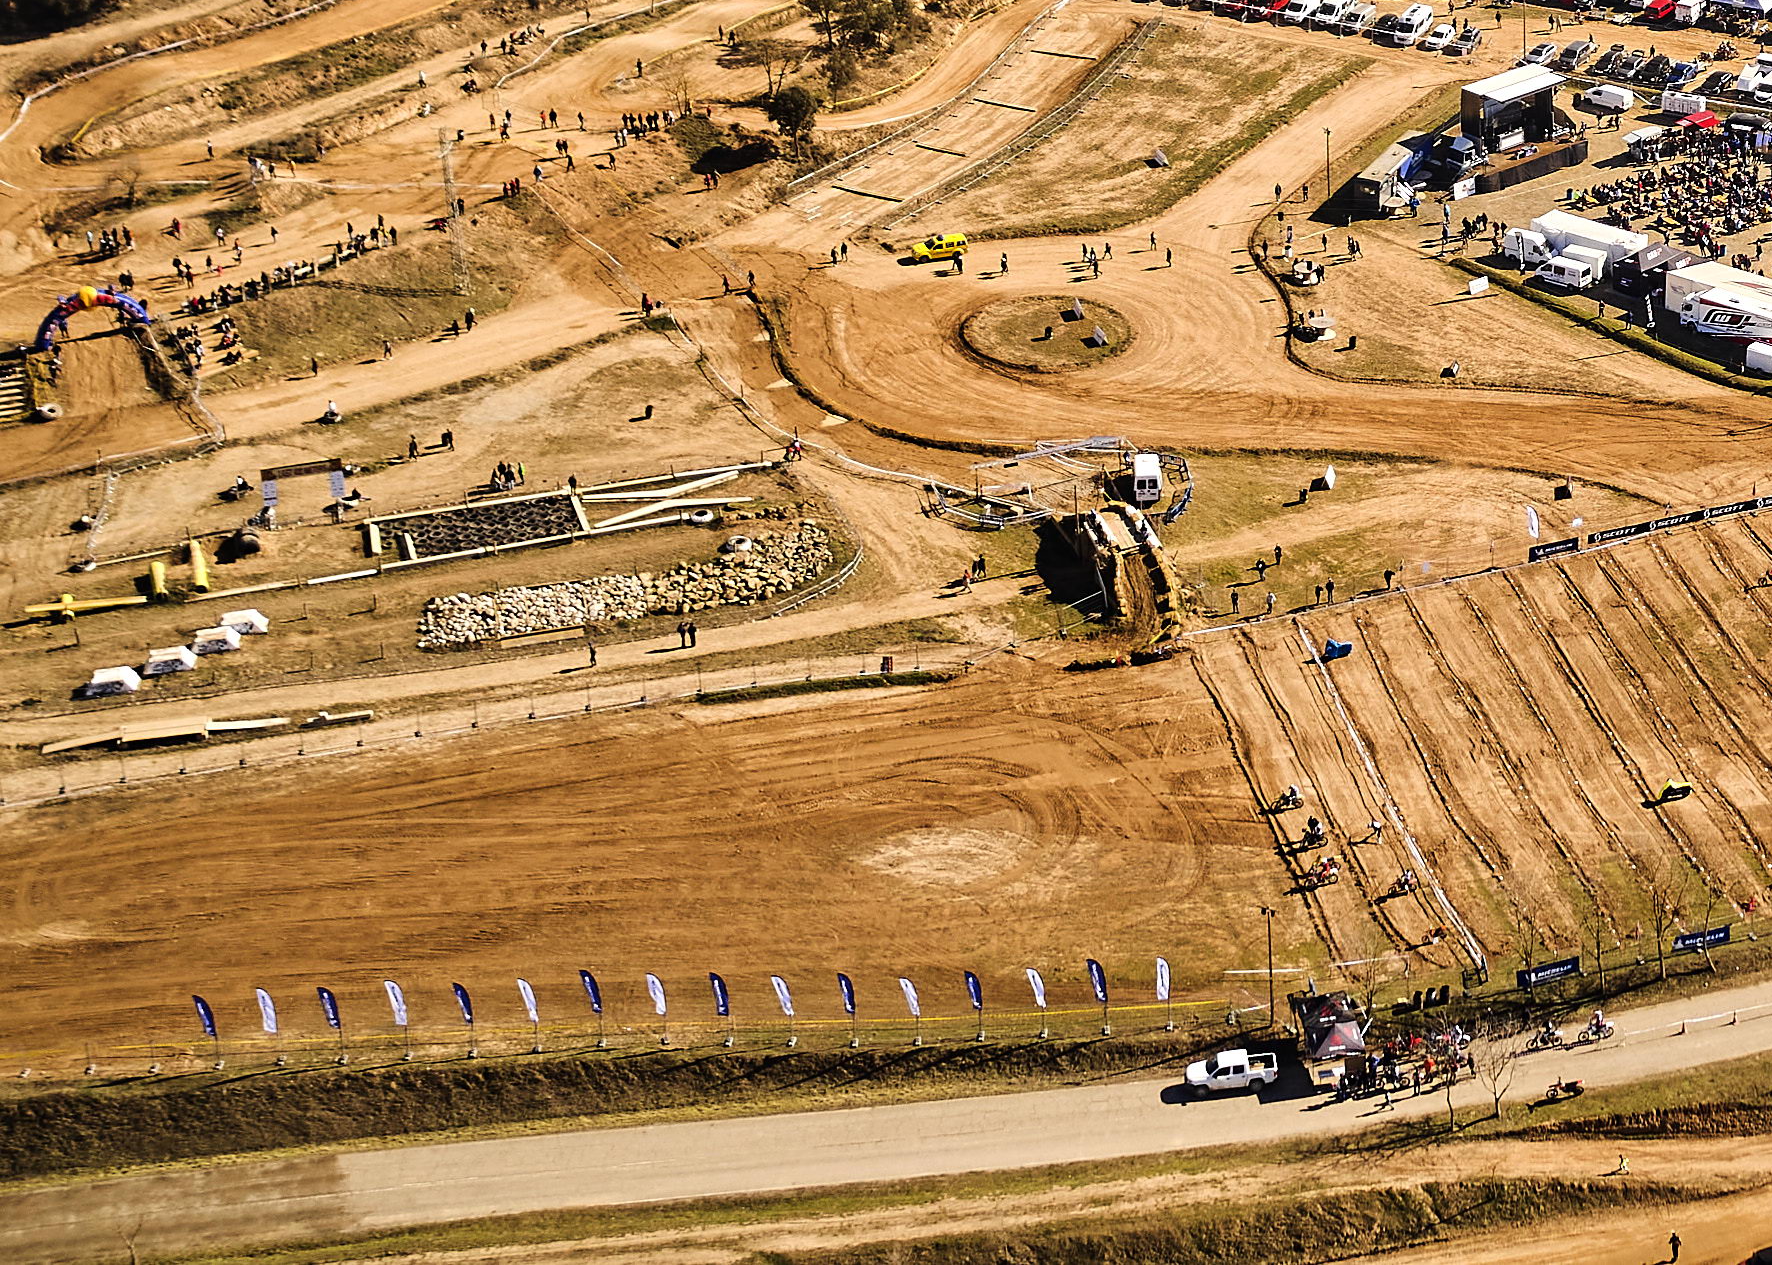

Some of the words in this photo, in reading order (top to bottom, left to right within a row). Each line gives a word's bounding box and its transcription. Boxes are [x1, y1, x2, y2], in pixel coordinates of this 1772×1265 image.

[1711, 503, 1745, 516] SCOTT
[1656, 514, 1692, 528] SCOTT
[1602, 527, 1637, 540] SCOTT
